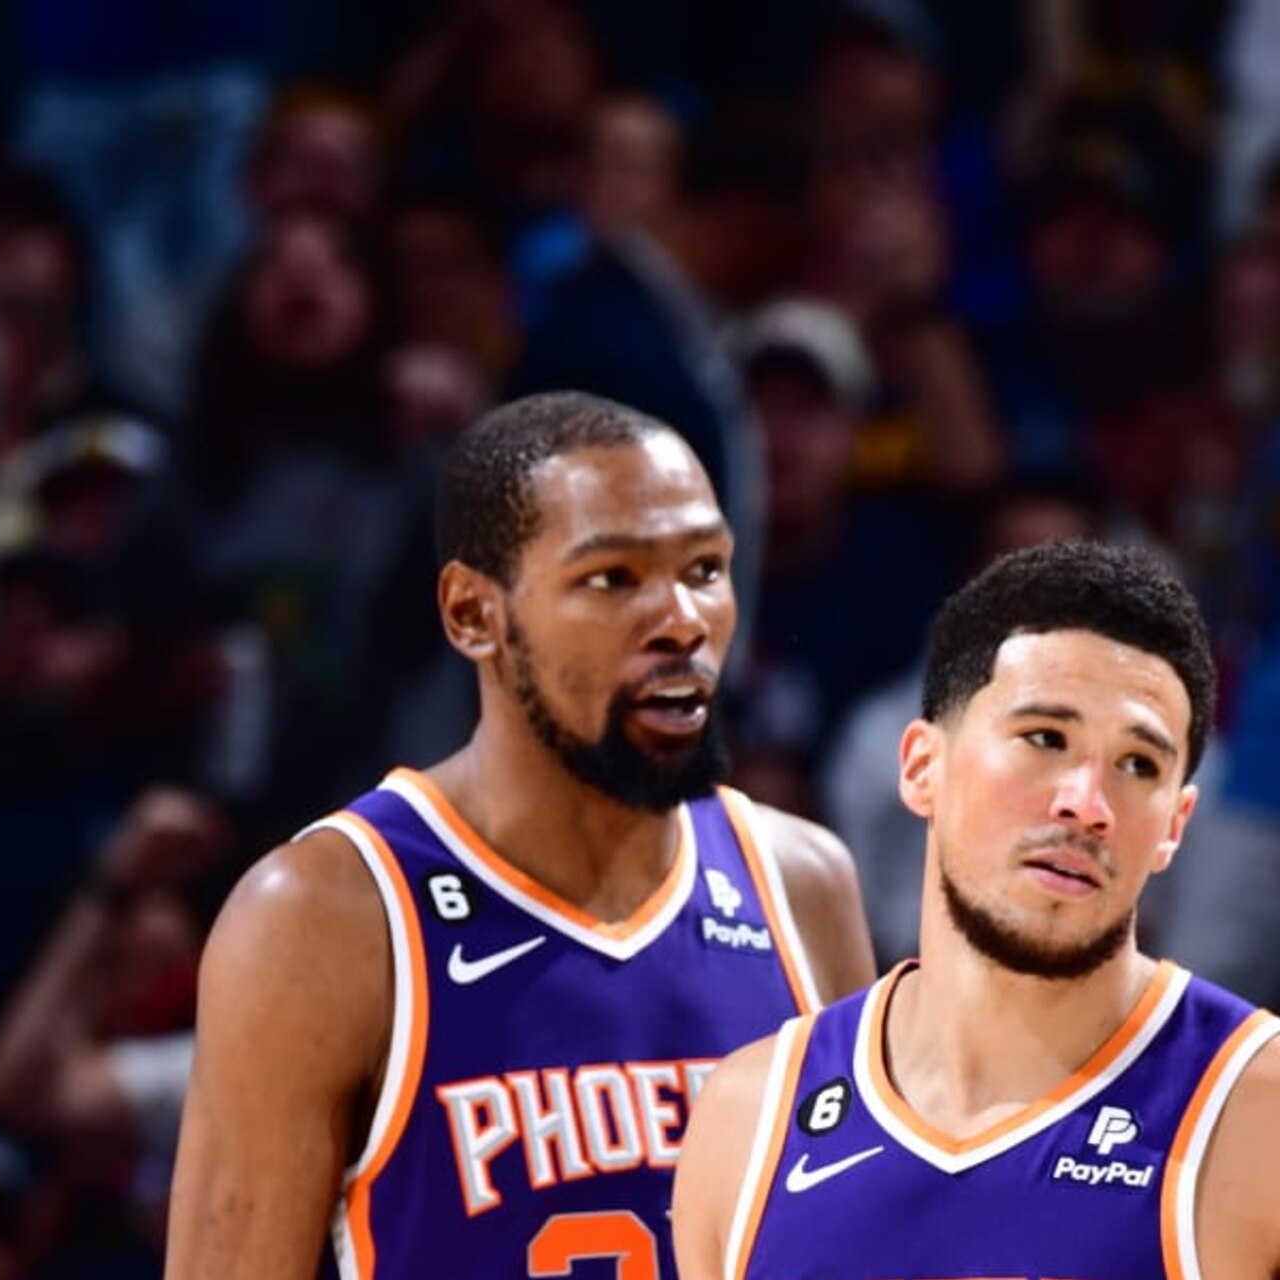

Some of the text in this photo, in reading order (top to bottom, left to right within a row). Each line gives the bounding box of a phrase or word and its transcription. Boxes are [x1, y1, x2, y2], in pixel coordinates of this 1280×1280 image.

[428, 874, 470, 920] 6
[702, 916, 772, 950] PayPal
[808, 1084, 845, 1131] 6
[436, 1057, 719, 1219] PHOE
[1053, 1156, 1154, 1187] PayPal
